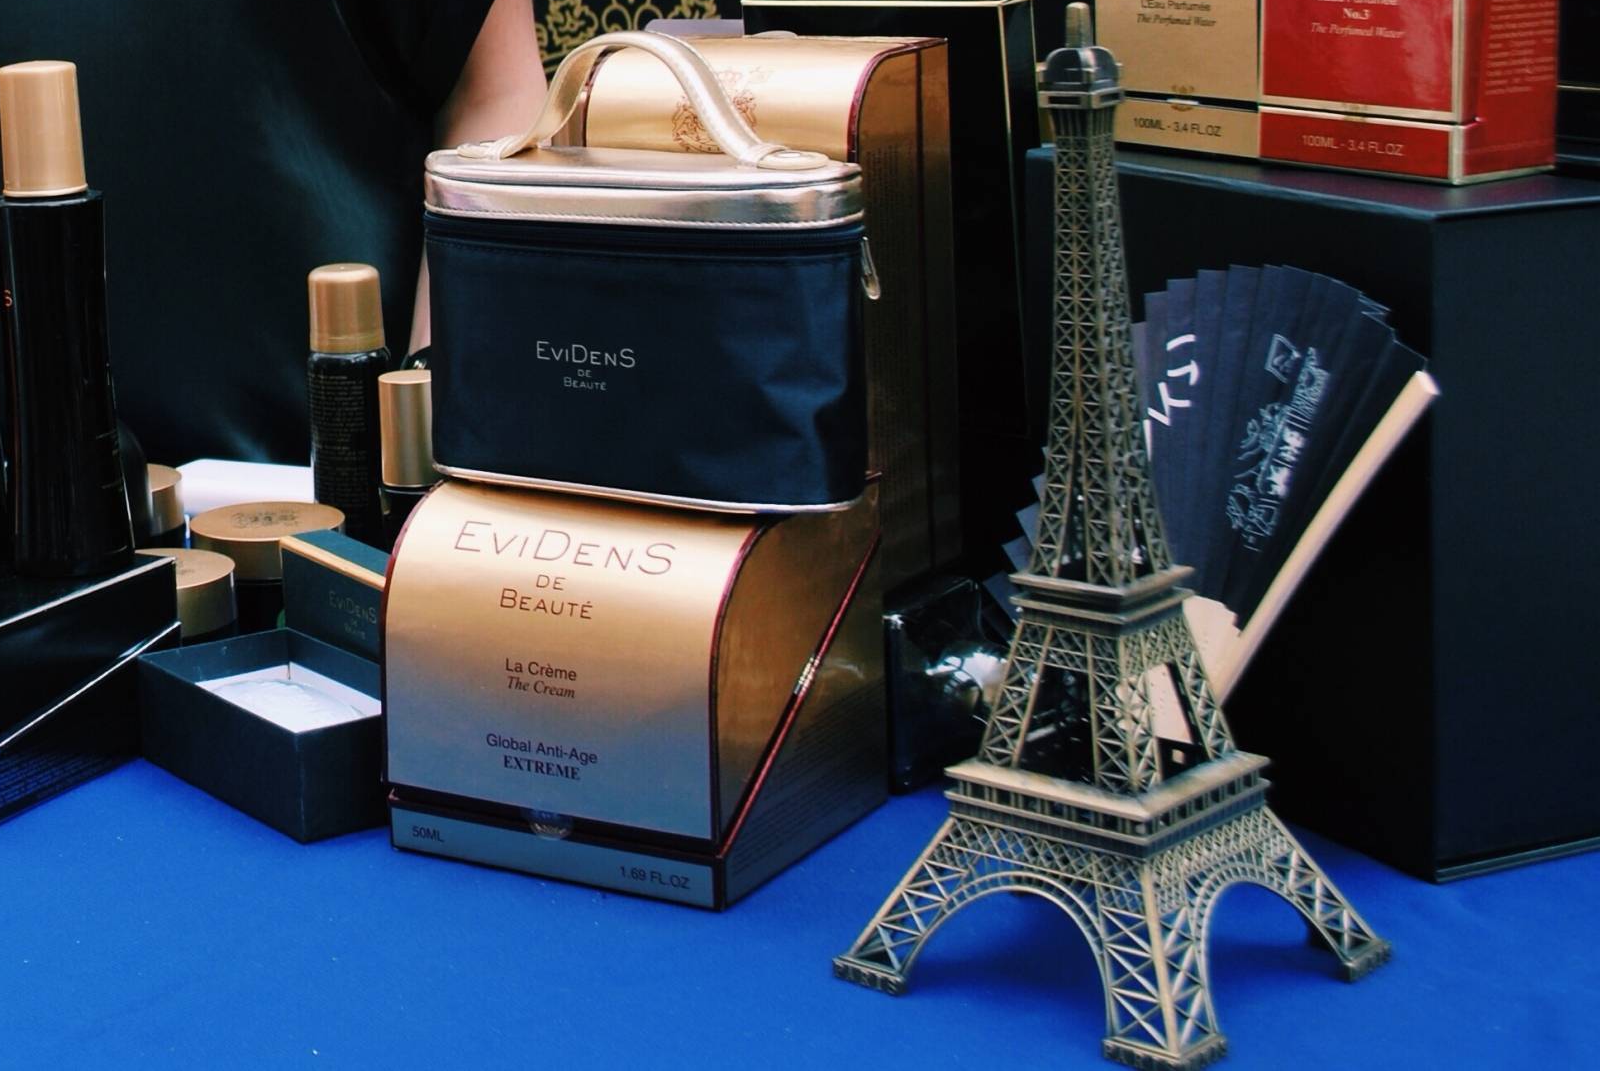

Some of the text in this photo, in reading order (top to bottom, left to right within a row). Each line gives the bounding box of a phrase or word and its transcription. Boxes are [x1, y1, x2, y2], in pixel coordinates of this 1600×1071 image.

[1301, 134, 1339, 149] 100ML
[577, 368, 593, 378] DE
[536, 574, 567, 591] DE
[500, 588, 593, 621] BEAUTÉ
[505, 657, 578, 682] La Crème
[507, 675, 576, 699] The Cream
[486, 733, 599, 767] Global Anti-Age
[503, 754, 582, 781] EXTREME
[411, 825, 445, 843] 50ML
[619, 865, 647, 881] 1.69
